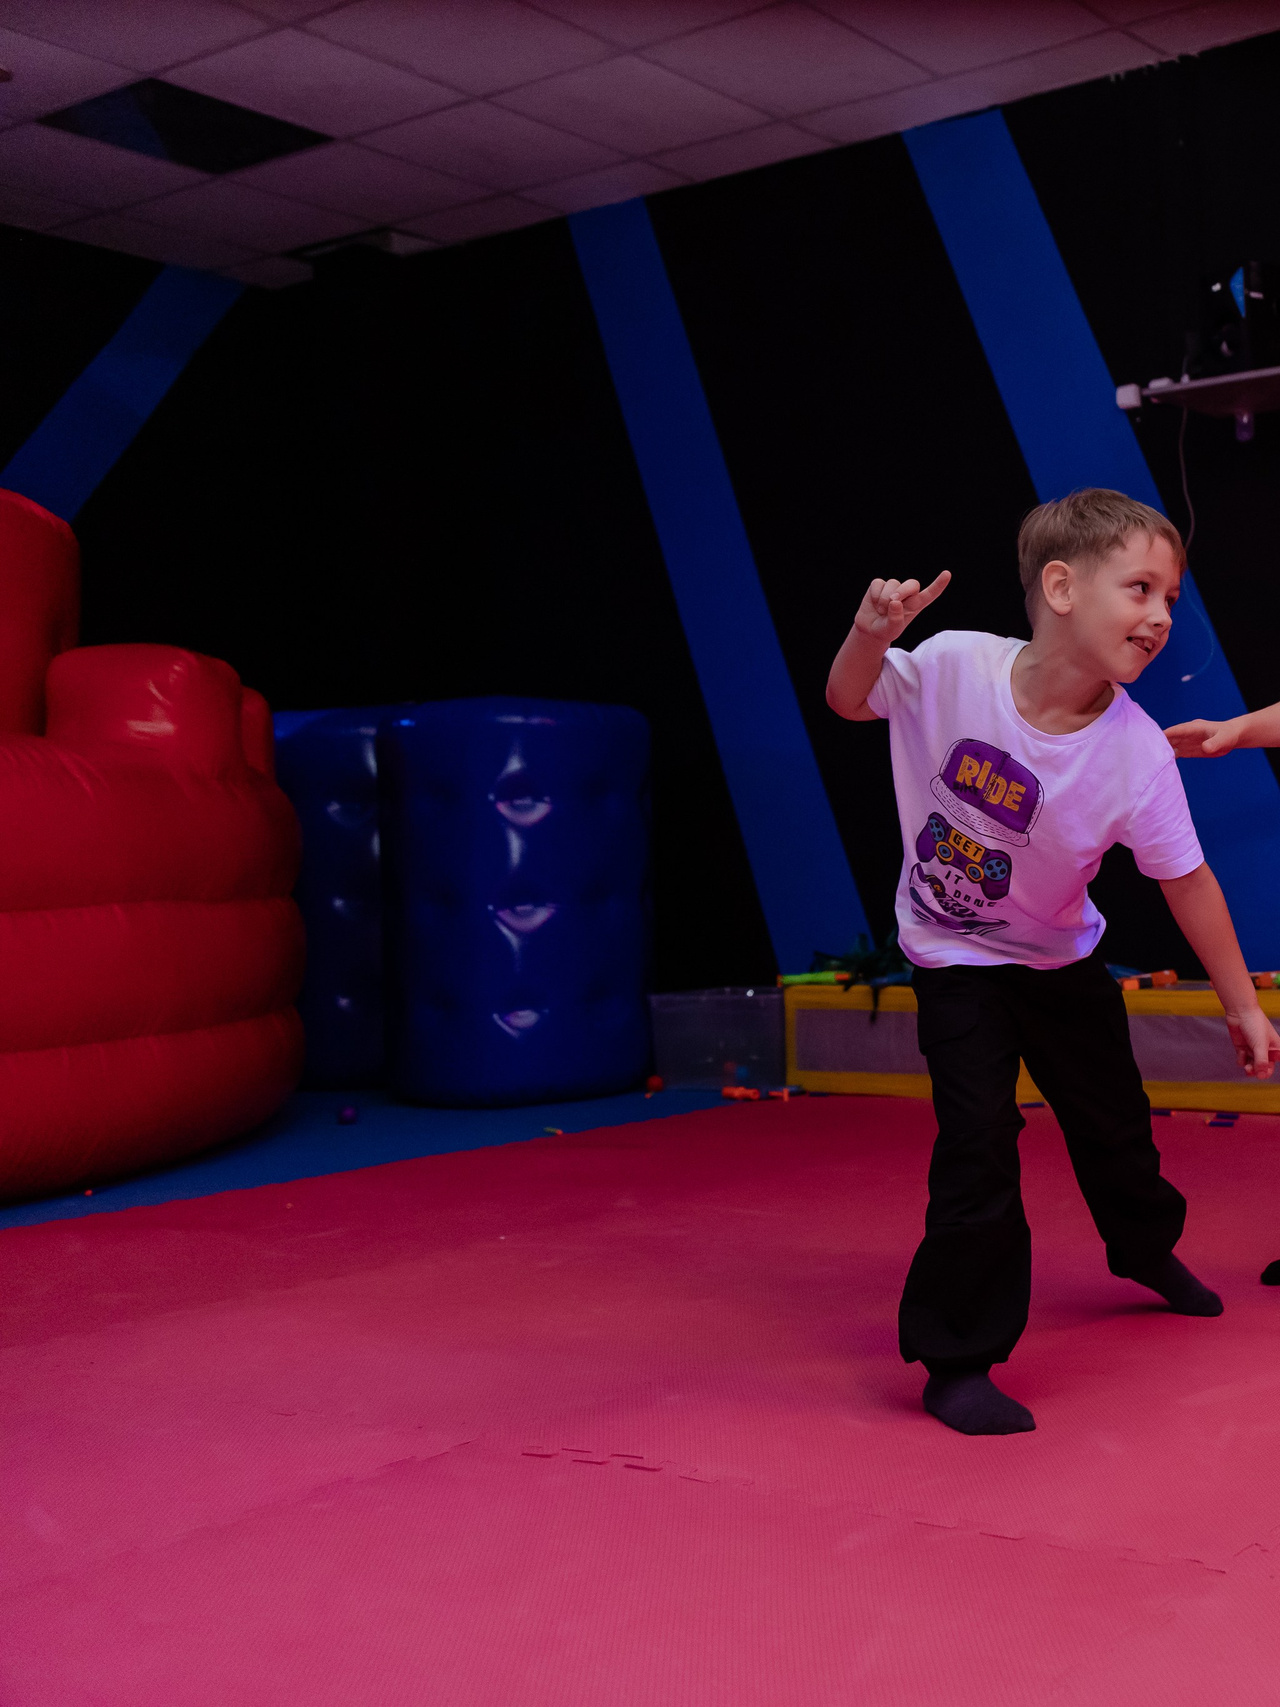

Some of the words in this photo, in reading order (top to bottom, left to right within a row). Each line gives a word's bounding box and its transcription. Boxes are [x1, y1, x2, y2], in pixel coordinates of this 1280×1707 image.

[955, 754, 1027, 812] RIDE
[952, 833, 983, 858] GET
[944, 870, 964, 884] IT
